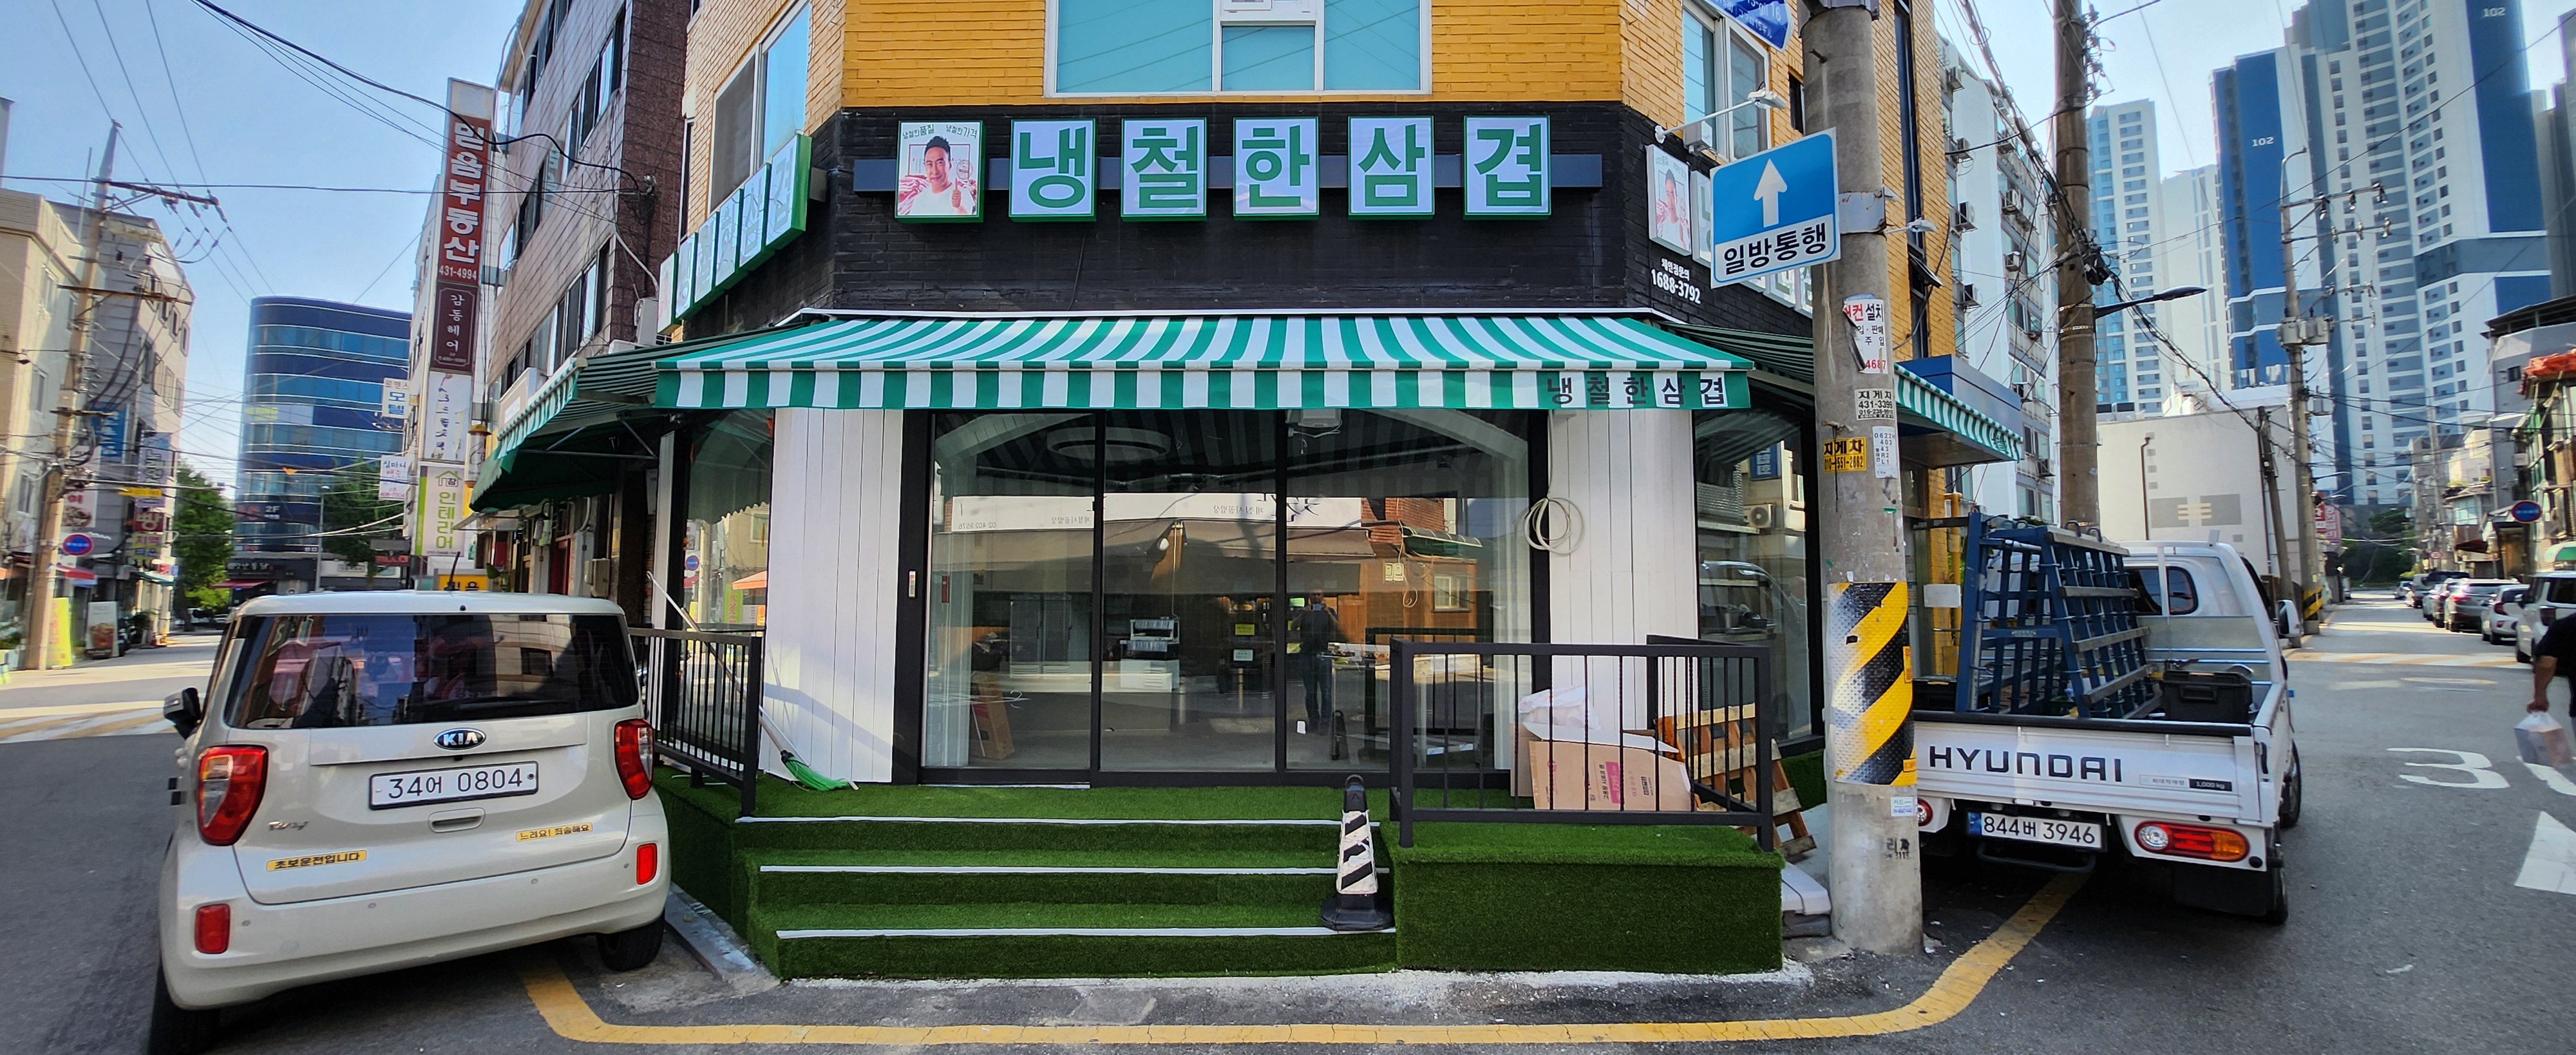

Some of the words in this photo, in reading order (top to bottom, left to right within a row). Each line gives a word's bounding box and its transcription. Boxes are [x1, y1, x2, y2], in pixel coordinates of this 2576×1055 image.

[2482, 7, 2506, 18] 102
[2252, 136, 2275, 147] 102
[1724, 222, 1826, 276] 일방통행
[439, 265, 477, 280] 431-4994
[1651, 269, 1701, 304] 1688-3792
[446, 294, 465, 352] 감동헤어
[1865, 303, 1884, 323] 설치
[1824, 439, 1864, 456] 지게차
[436, 491, 457, 549] 인테리어
[442, 731, 479, 747] KIA
[1929, 745, 2123, 783] HYUNDAI
[388, 775, 442, 799] 34어
[457, 768, 524, 792] 0804
[520, 829, 551, 840] 느려요!
[1983, 816, 2037, 837] 844버
[2043, 822, 2096, 844] 3946
[275, 851, 361, 870] 초보운전입니다
